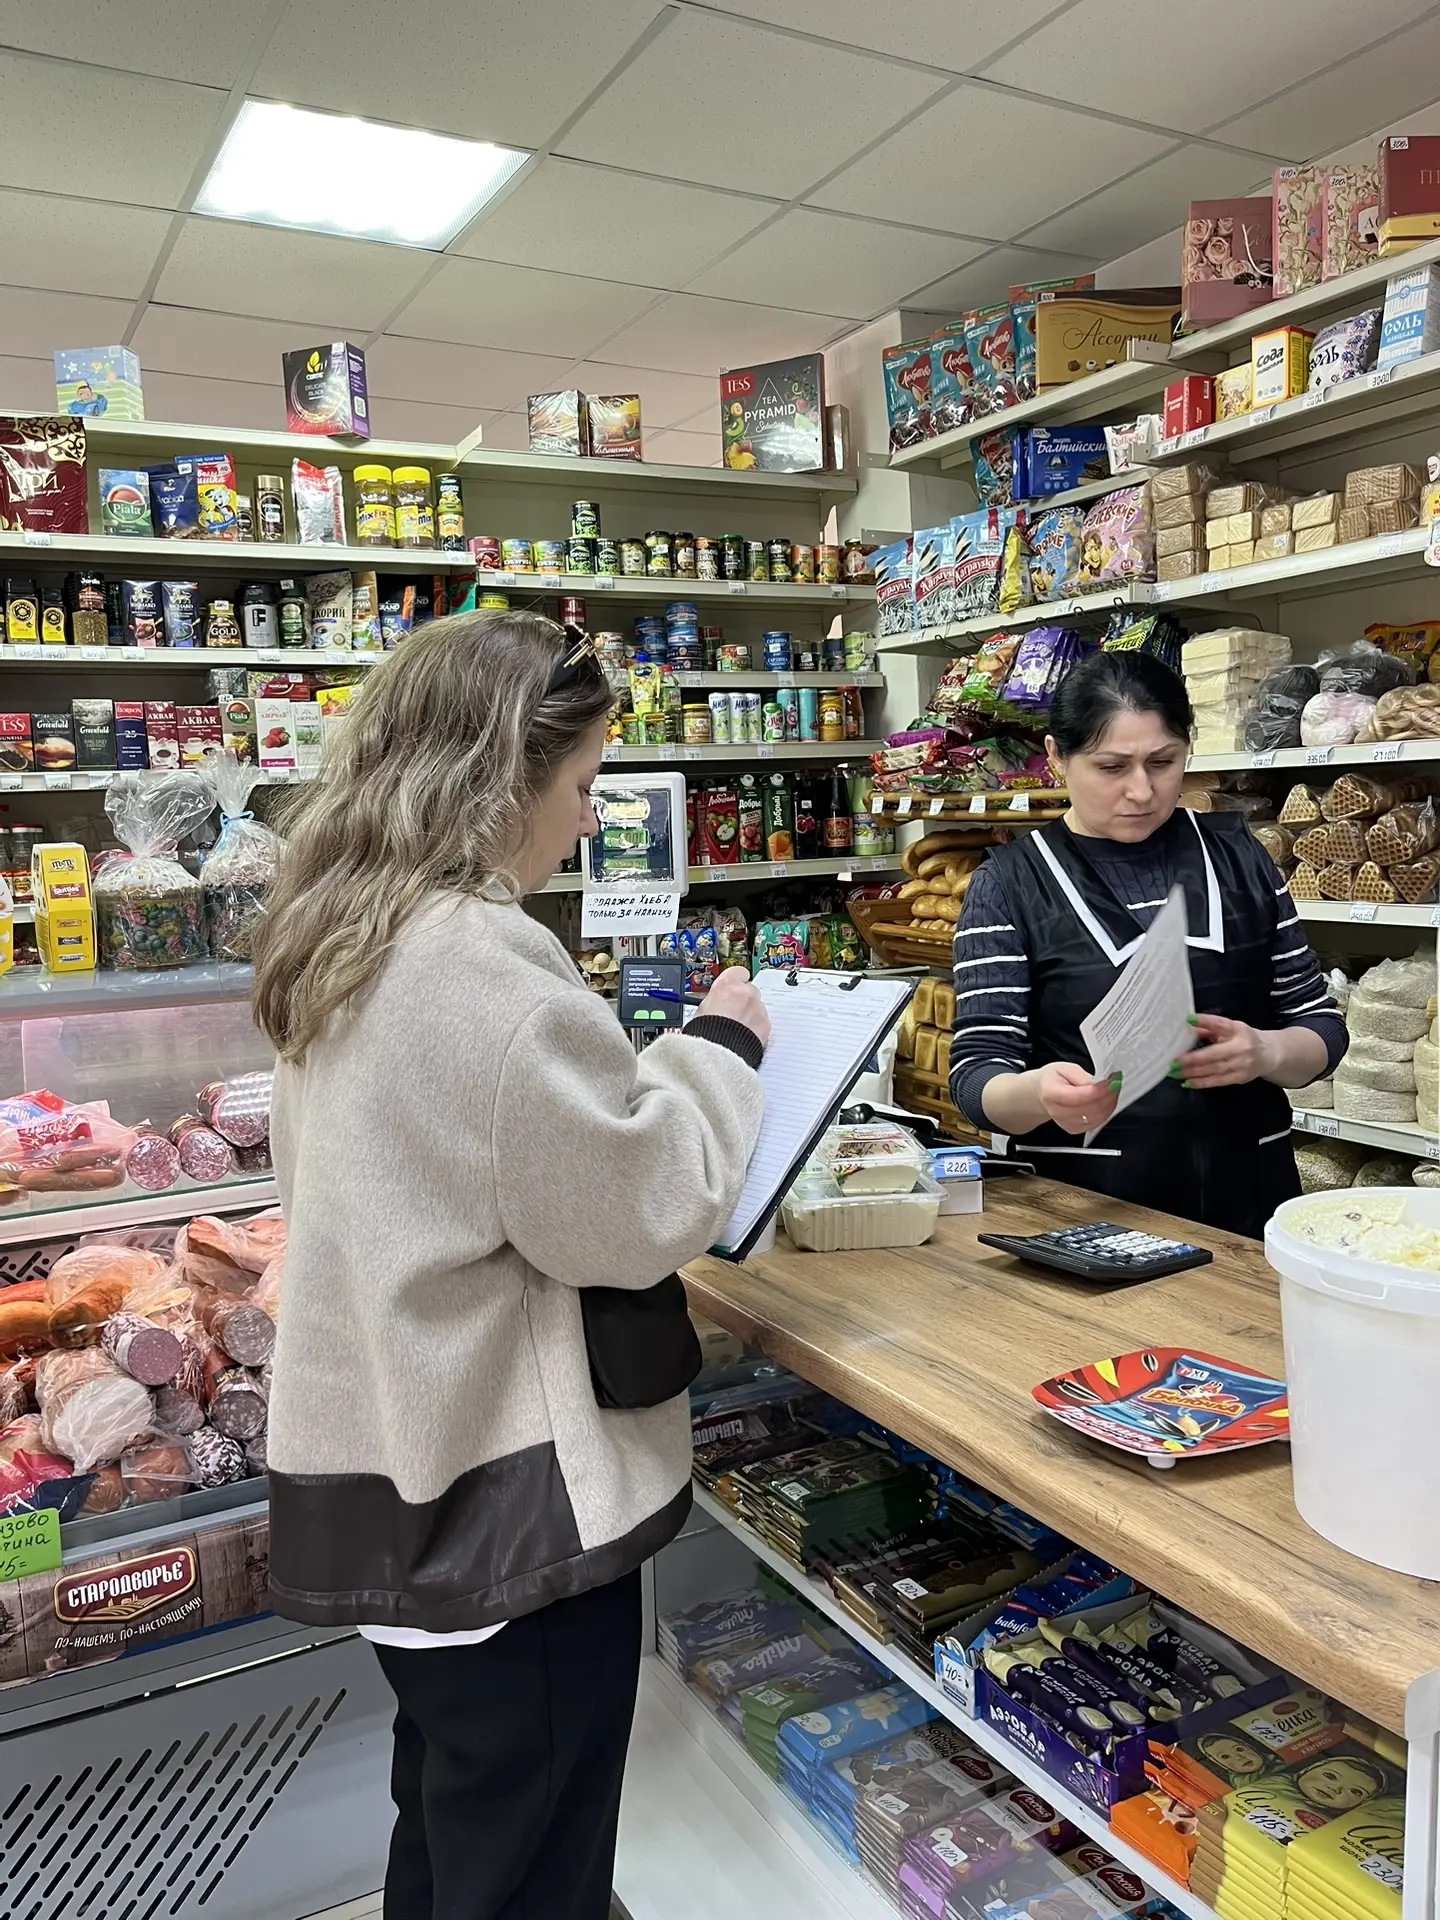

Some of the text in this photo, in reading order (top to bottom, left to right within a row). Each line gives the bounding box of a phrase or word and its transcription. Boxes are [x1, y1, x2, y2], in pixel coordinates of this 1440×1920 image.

[1256, 347, 1284, 369] Сода
[726, 376, 751, 394] TESS
[762, 396, 778, 405] TEA
[744, 403, 797, 423] PYRAMID
[112, 503, 142, 516] Piala
[211, 626, 238, 637] GOLD
[36, 719, 69, 730] Greenfield
[147, 712, 175, 721] AKBAR
[181, 715, 217, 726] AKBAR
[228, 711, 251, 721] Piala
[79, 724, 110, 735] Greenfield
[772, 795, 784, 827] Добрый
[67, 1561, 183, 1608] СТАРОДВОРЬЕ
[54, 1595, 205, 1650] ПО-НАШЕМУ, ПО-НАСТОЯЩЕМУ!
[714, 1607, 755, 1631] Milka
[740, 1634, 801, 1672] Milka
[1272, 1707, 1318, 1734] ёнка
[1023, 1792, 1052, 1820] Россия
[1111, 1871, 1140, 1898] Россия
